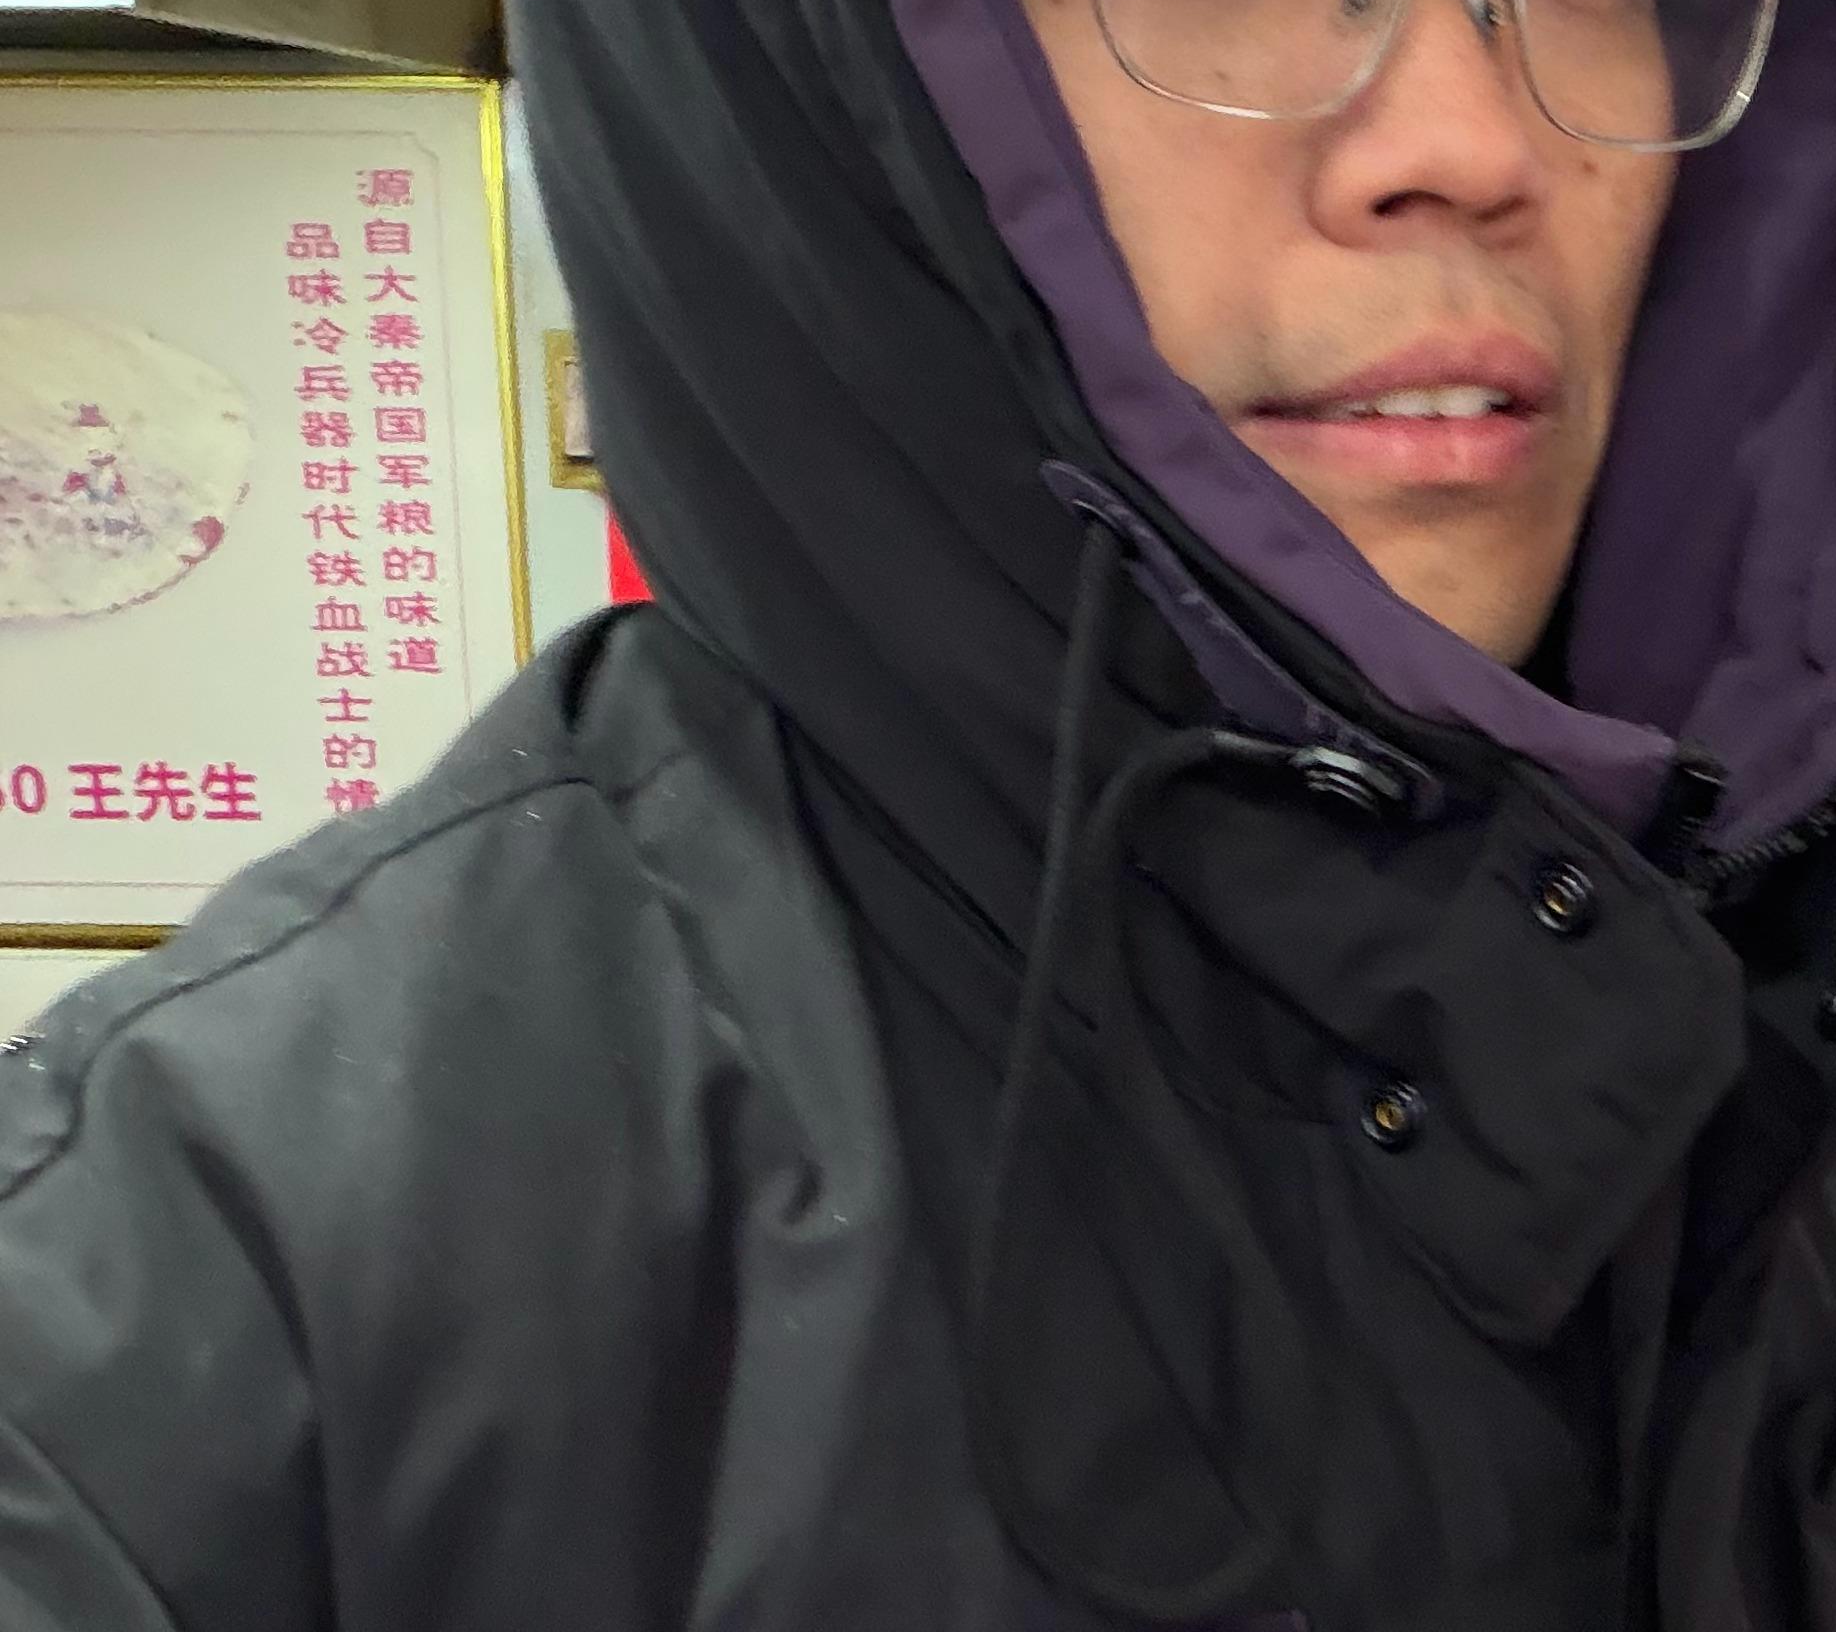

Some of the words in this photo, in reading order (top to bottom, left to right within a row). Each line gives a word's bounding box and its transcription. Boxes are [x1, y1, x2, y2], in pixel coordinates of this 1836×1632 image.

[356, 169, 443, 675] 源自大秦帝国军粮的味道
[0, 763, 47, 814] 0
[67, 760, 263, 822] 王先生
